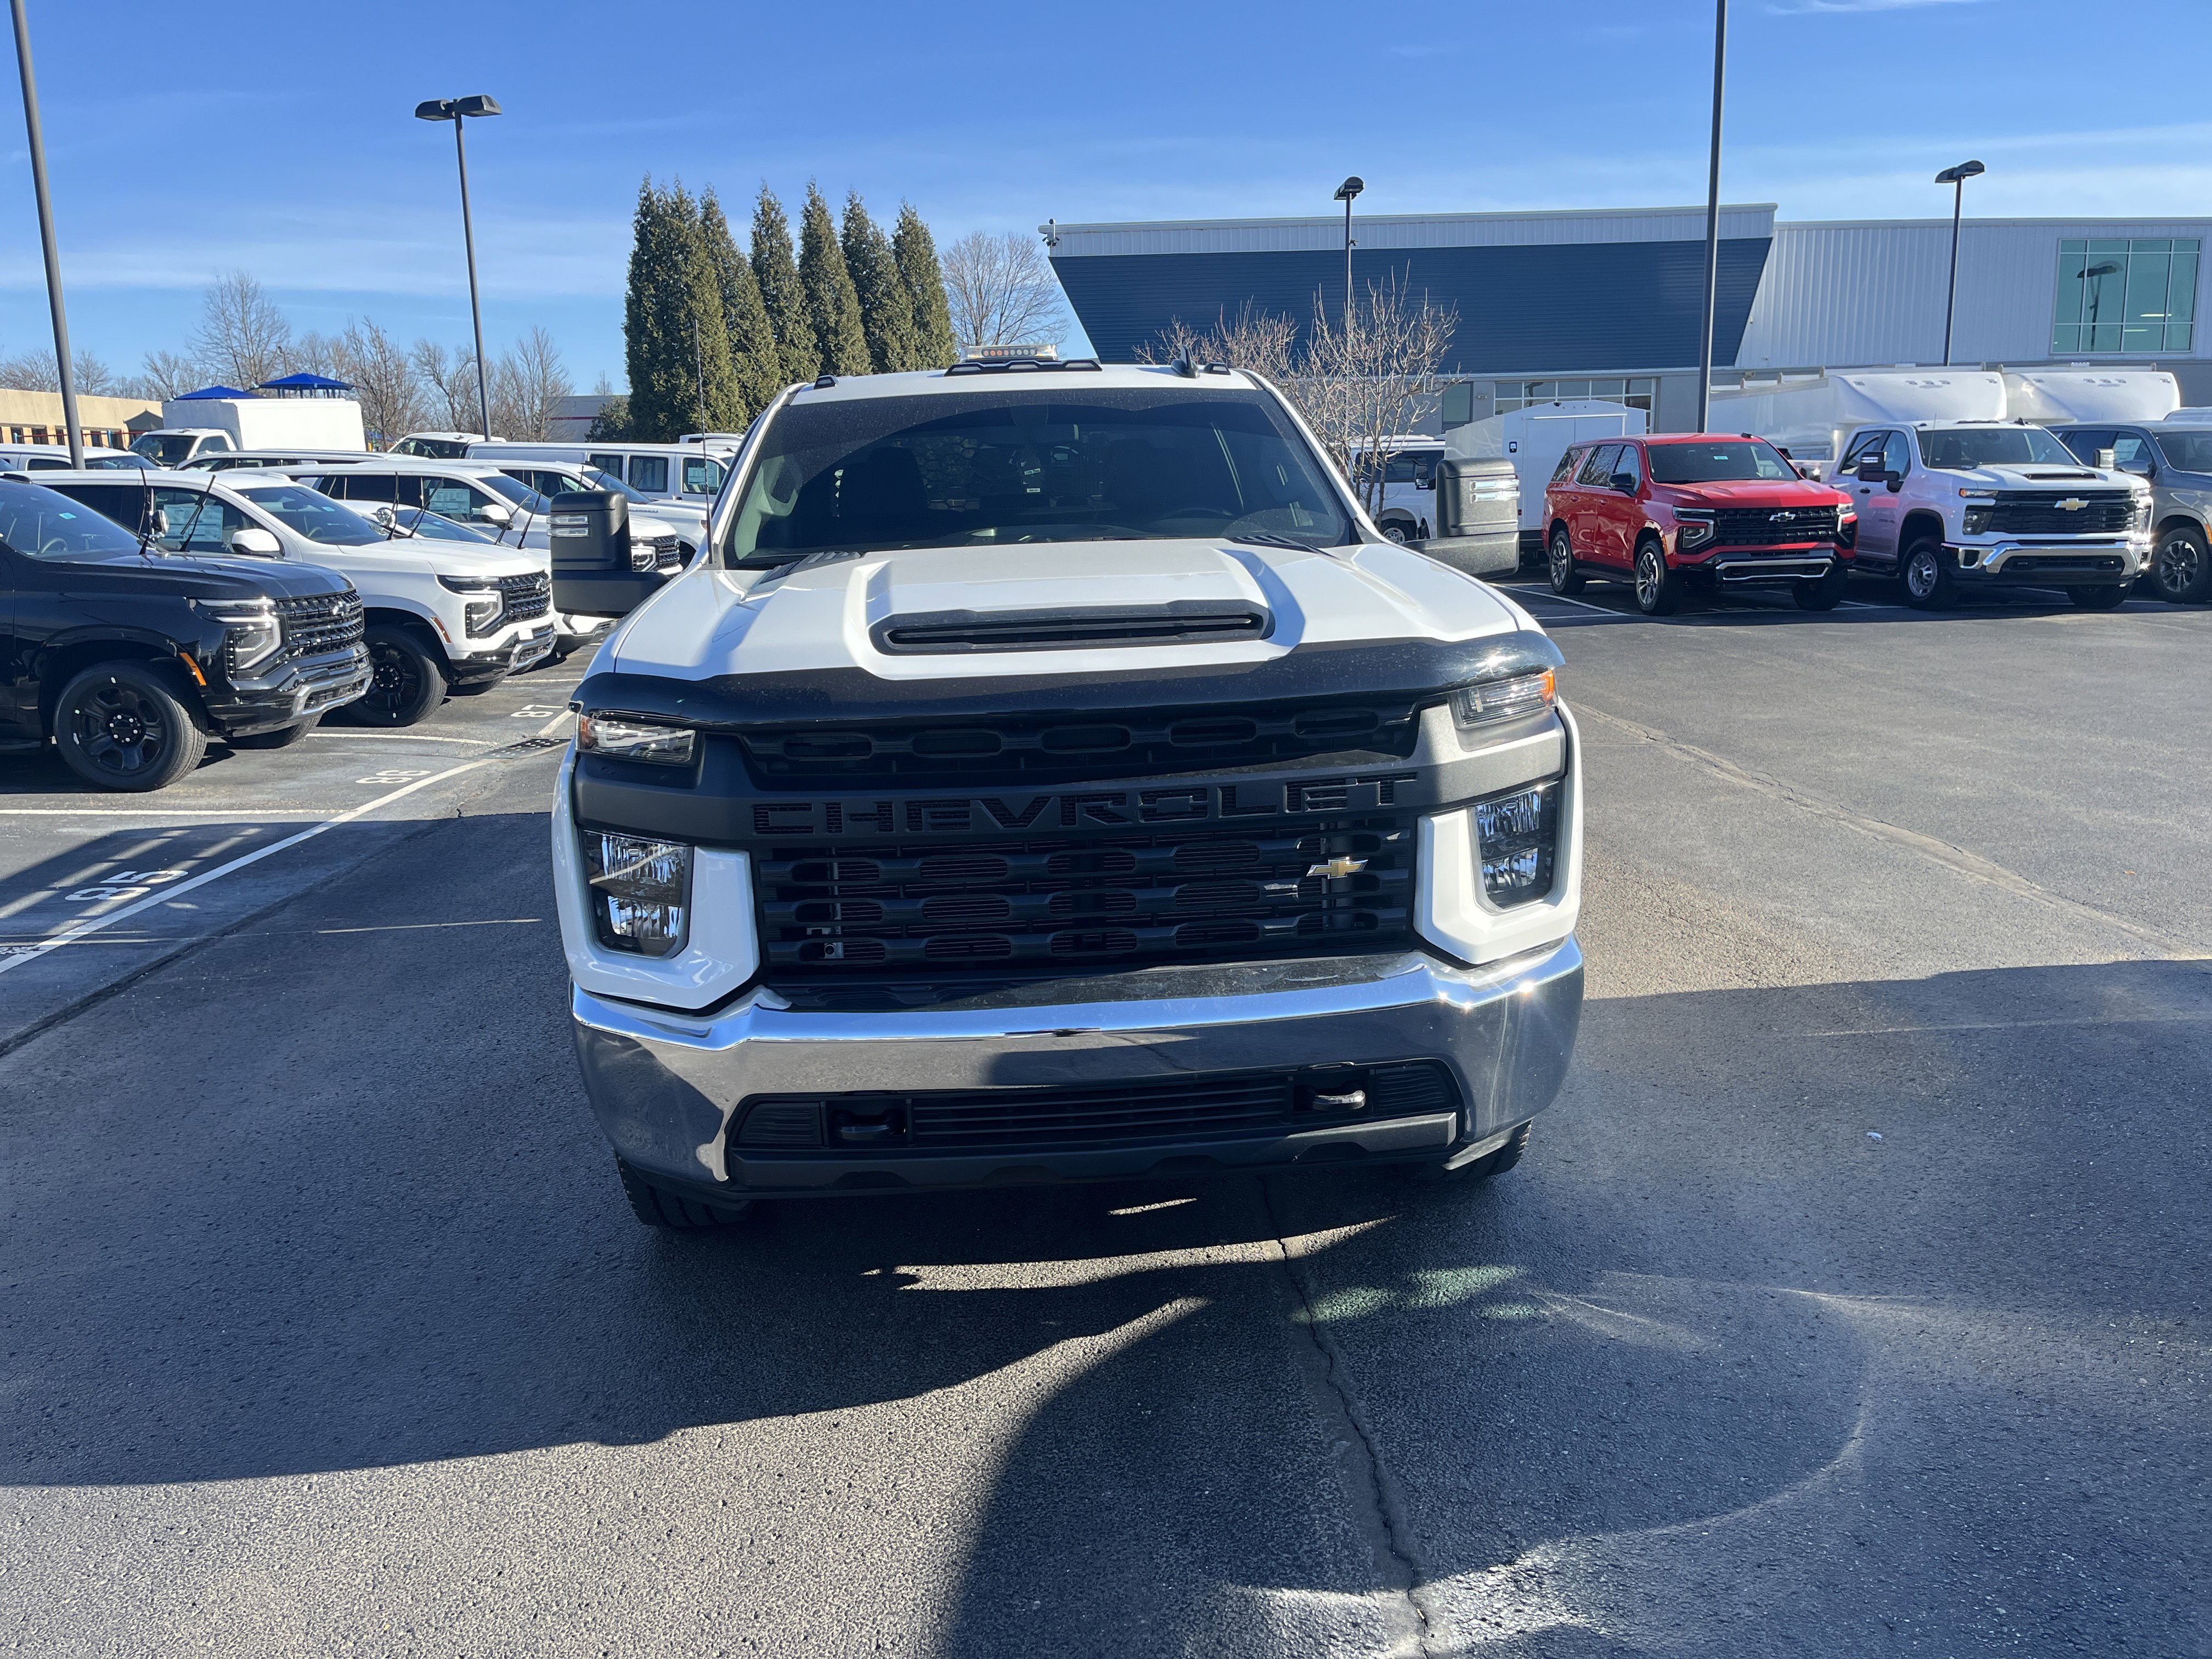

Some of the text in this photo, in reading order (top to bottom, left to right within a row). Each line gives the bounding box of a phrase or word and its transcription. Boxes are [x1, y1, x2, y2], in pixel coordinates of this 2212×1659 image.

[355, 770, 432, 784] 86
[752, 771, 1419, 835] CHEVROLET
[65, 870, 189, 901] 85
